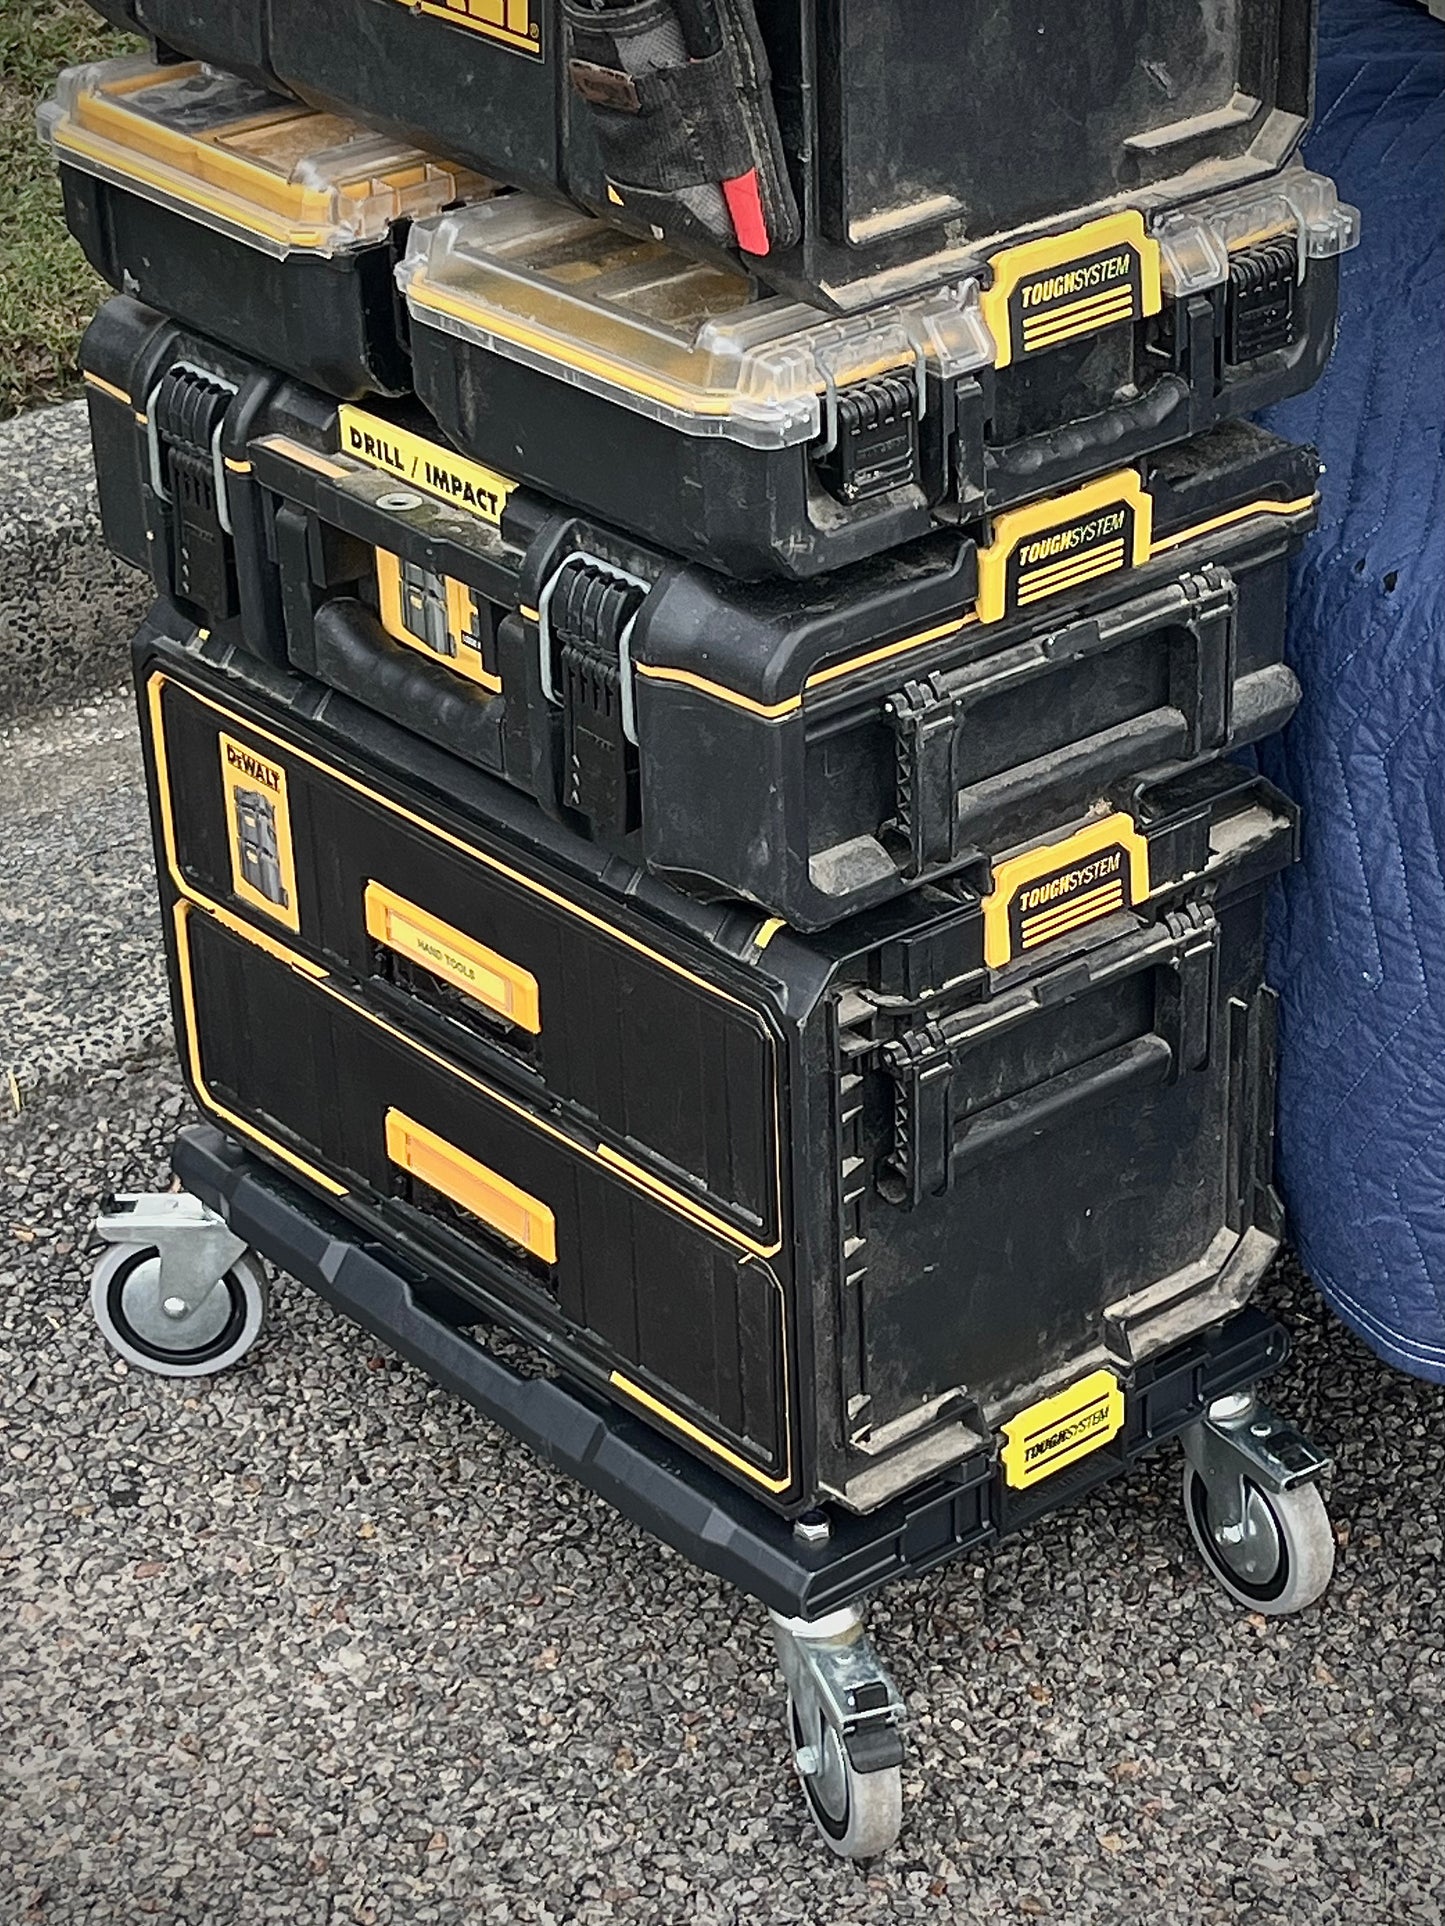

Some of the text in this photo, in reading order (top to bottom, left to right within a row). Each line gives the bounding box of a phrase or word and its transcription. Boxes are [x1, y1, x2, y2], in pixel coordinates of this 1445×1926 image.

[1020, 253, 1131, 308] TOUGHSYSTEM
[349, 425, 499, 516] DRILL / IMPACT
[1019, 510, 1125, 567] TOUGHSYSTEM
[1020, 851, 1122, 912] TOUGHSYSTEM
[416, 938, 476, 980] HAND TOOLS
